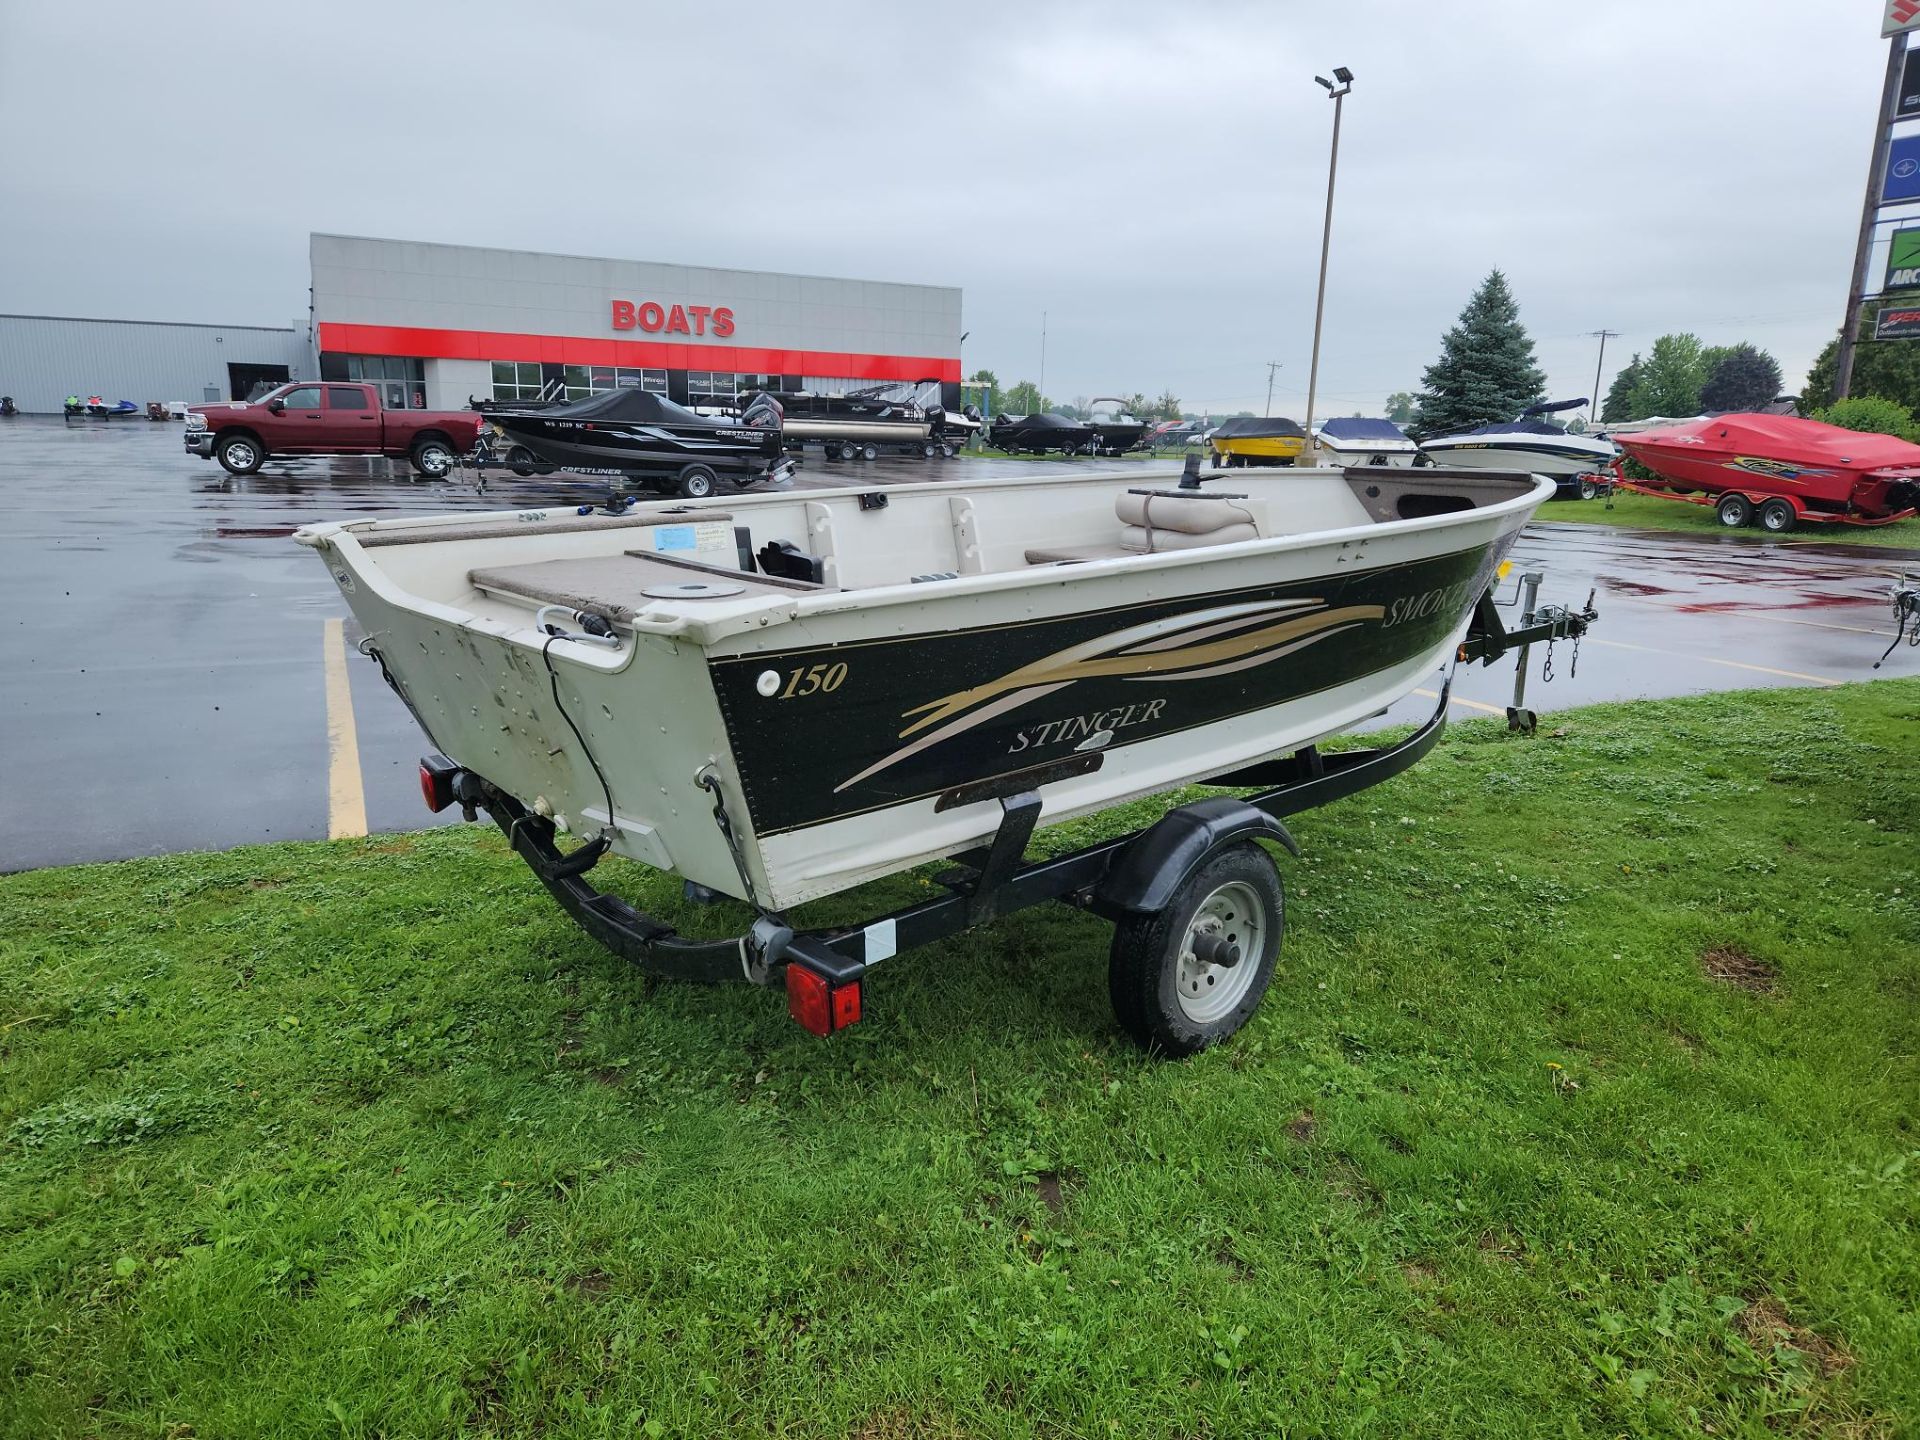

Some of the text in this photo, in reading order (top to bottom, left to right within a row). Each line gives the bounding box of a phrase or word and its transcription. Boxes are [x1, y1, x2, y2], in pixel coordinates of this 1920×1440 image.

[611, 299, 735, 338] BOATS
[715, 430, 764, 438] CRESTLINER
[560, 466, 621, 475] CRESTLINER
[778, 662, 848, 700] 150
[1007, 699, 1167, 754] STINGER
